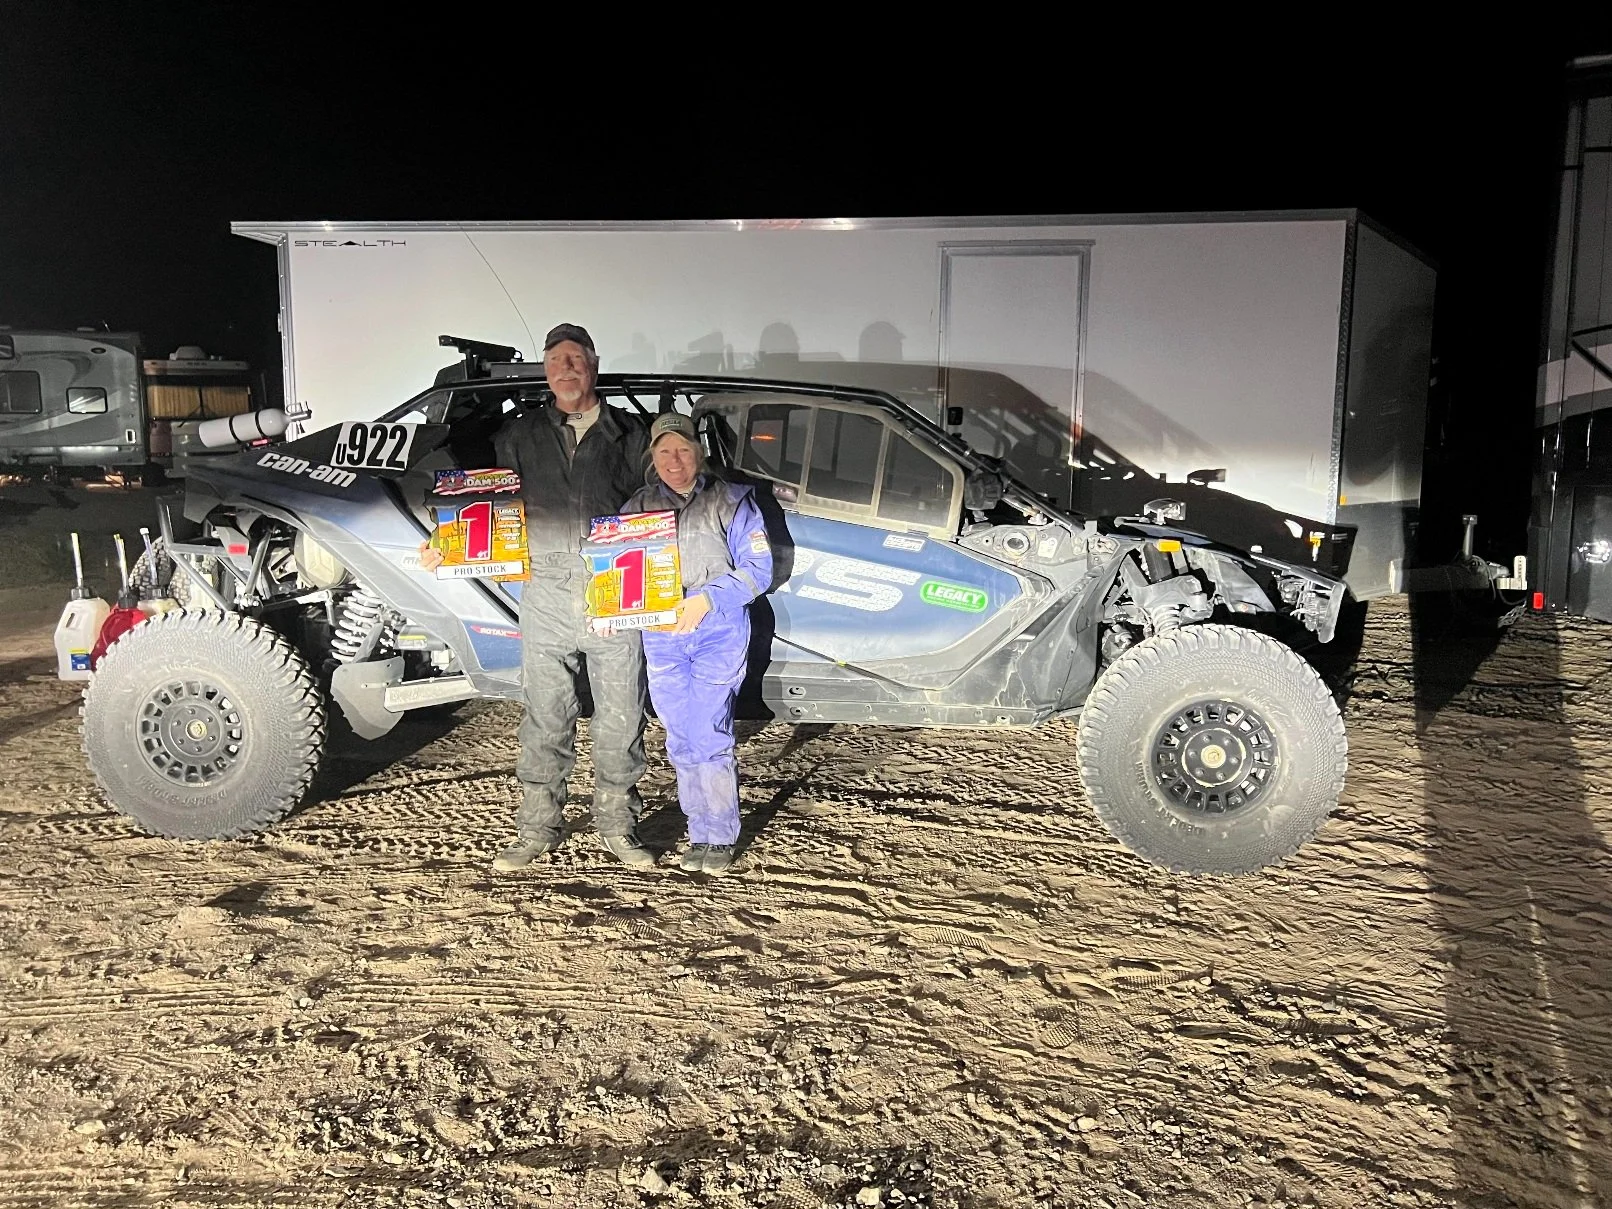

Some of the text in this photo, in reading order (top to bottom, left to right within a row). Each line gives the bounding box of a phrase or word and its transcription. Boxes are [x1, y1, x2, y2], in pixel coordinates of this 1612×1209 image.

[256, 452, 357, 488] can-am
[466, 478, 492, 487] DAM
[495, 477, 516, 486] 500
[459, 501, 492, 561] 1
[454, 565, 507, 575] PRO STOCK
[613, 547, 647, 611] 1
[926, 584, 983, 605] LEGACY
[609, 615, 661, 627] PRO STOCK
